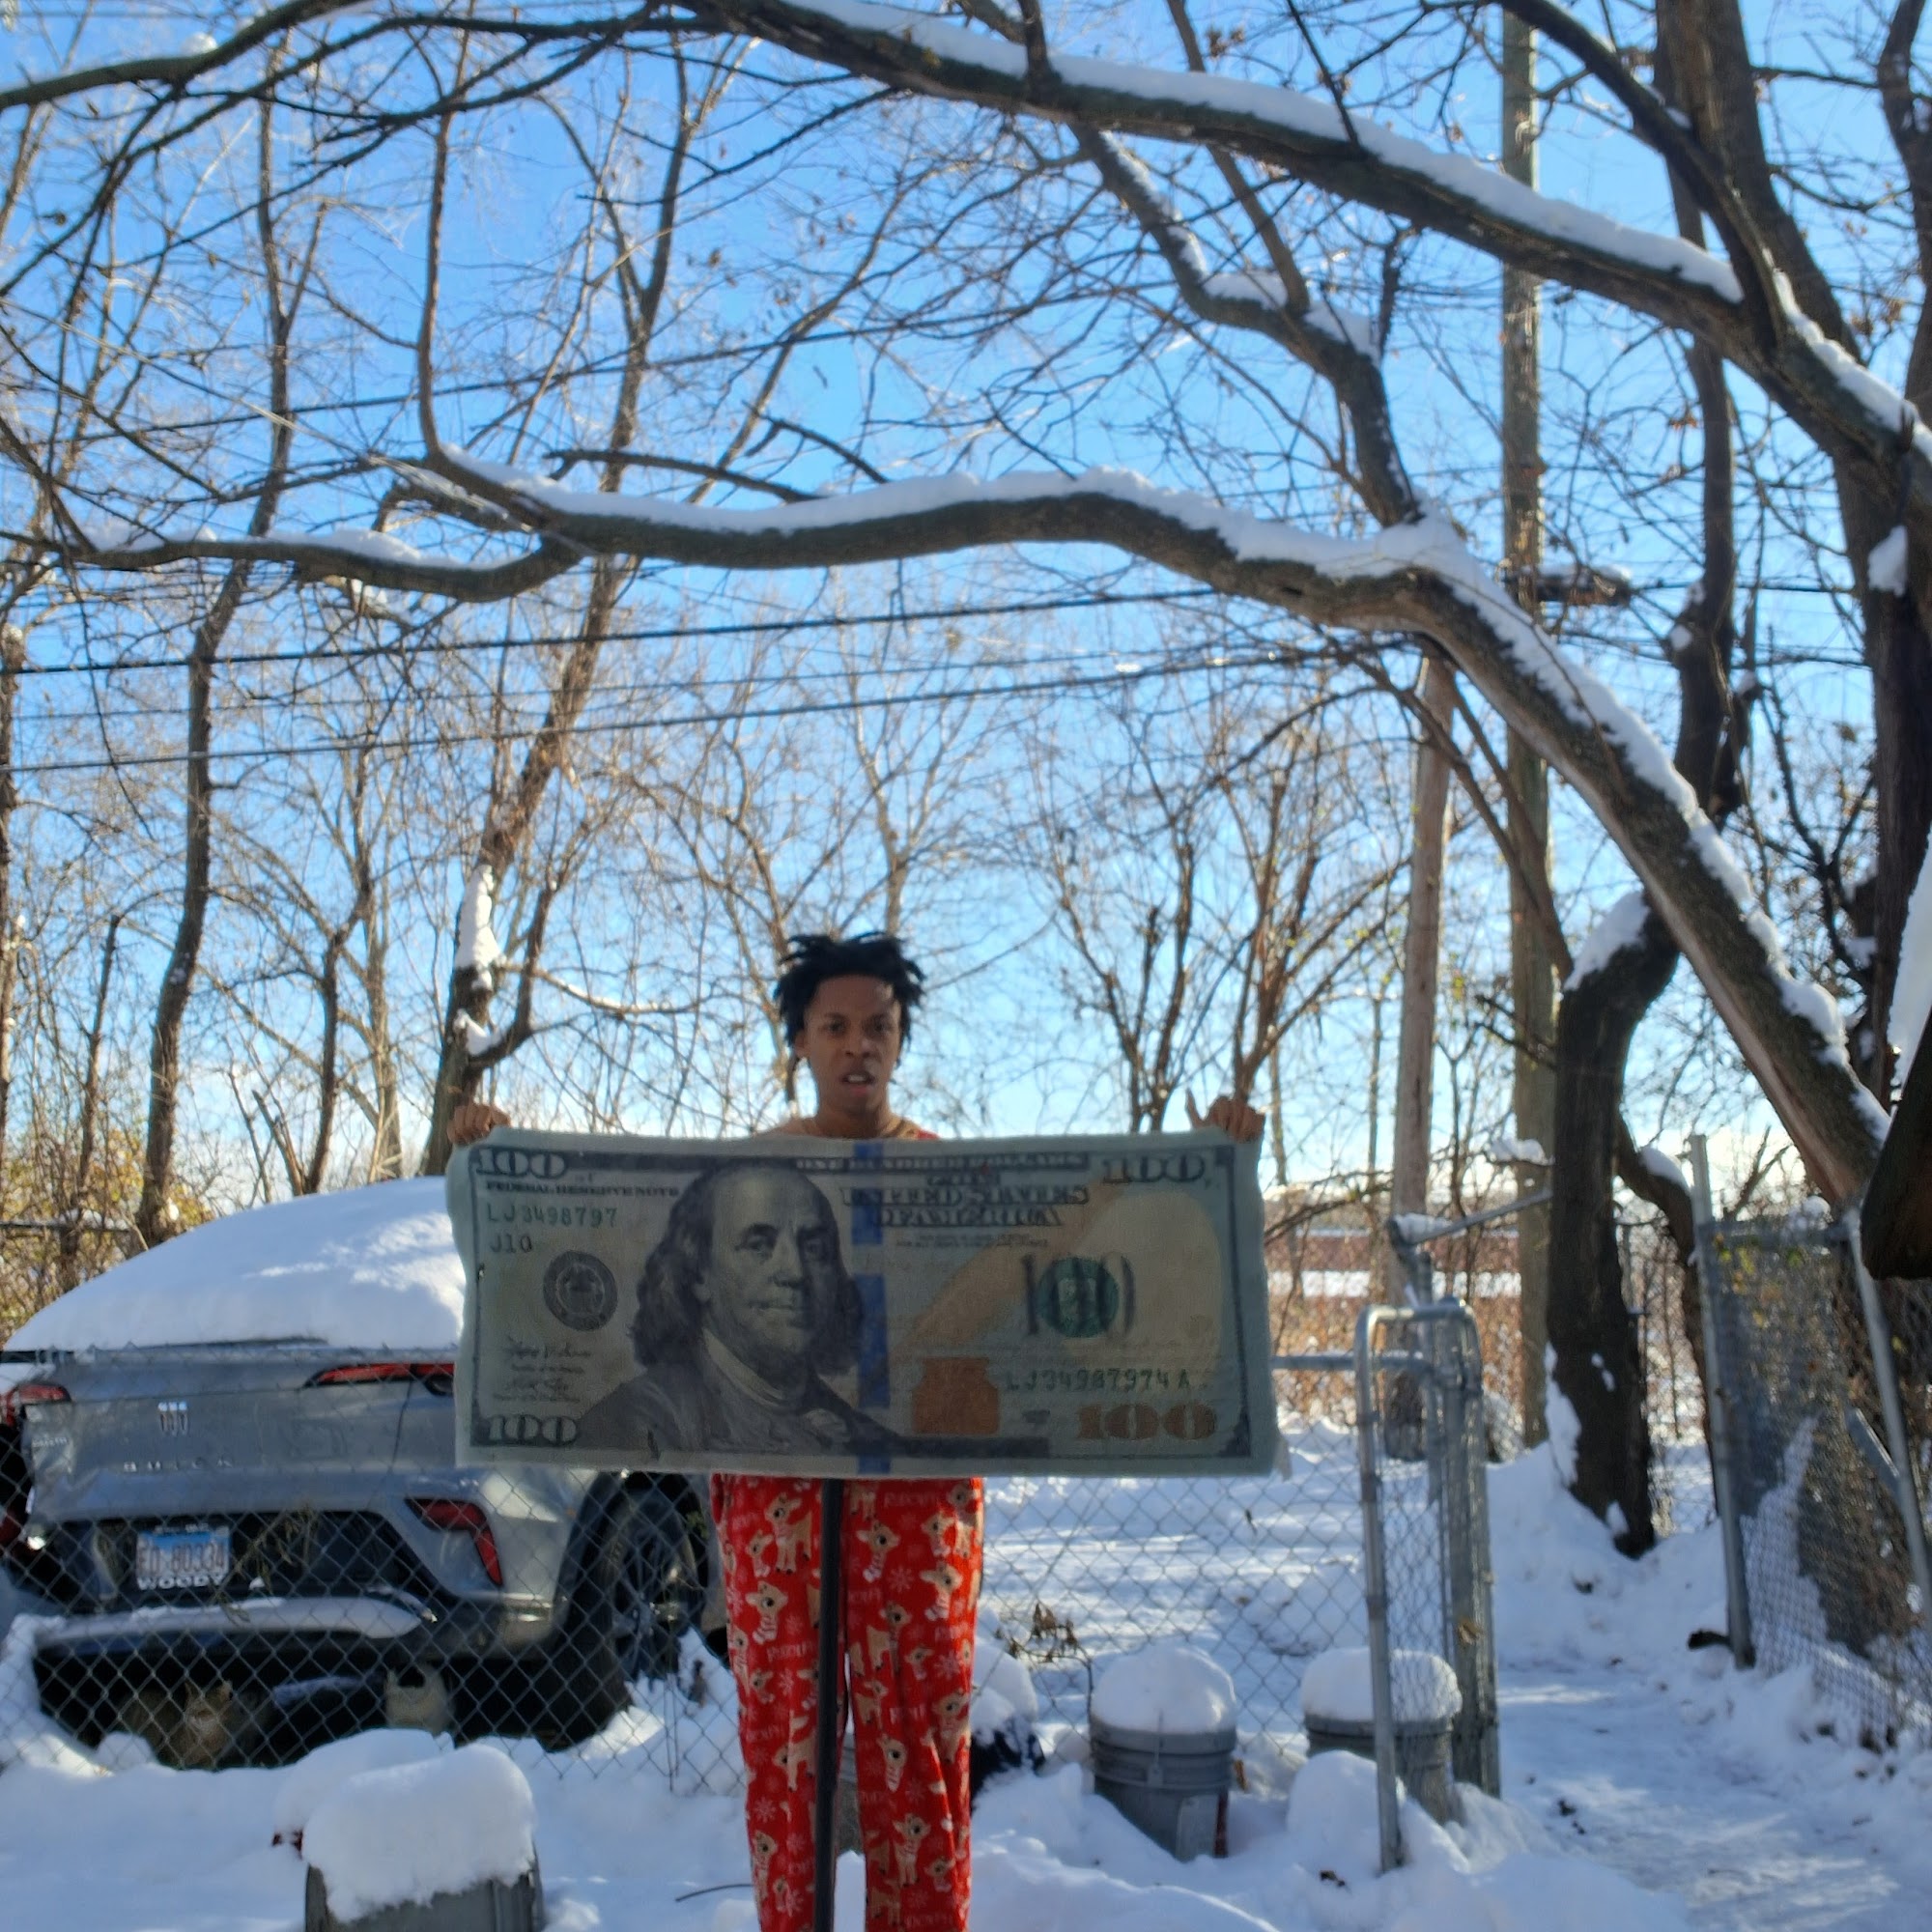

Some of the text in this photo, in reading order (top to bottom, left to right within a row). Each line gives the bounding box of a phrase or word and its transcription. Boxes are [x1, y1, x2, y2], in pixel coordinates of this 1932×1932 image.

[476, 1148, 568, 1179] 100
[1101, 1154, 1206, 1184] 100
[484, 1414, 578, 1446] 100
[1077, 1402, 1218, 1440] 100
